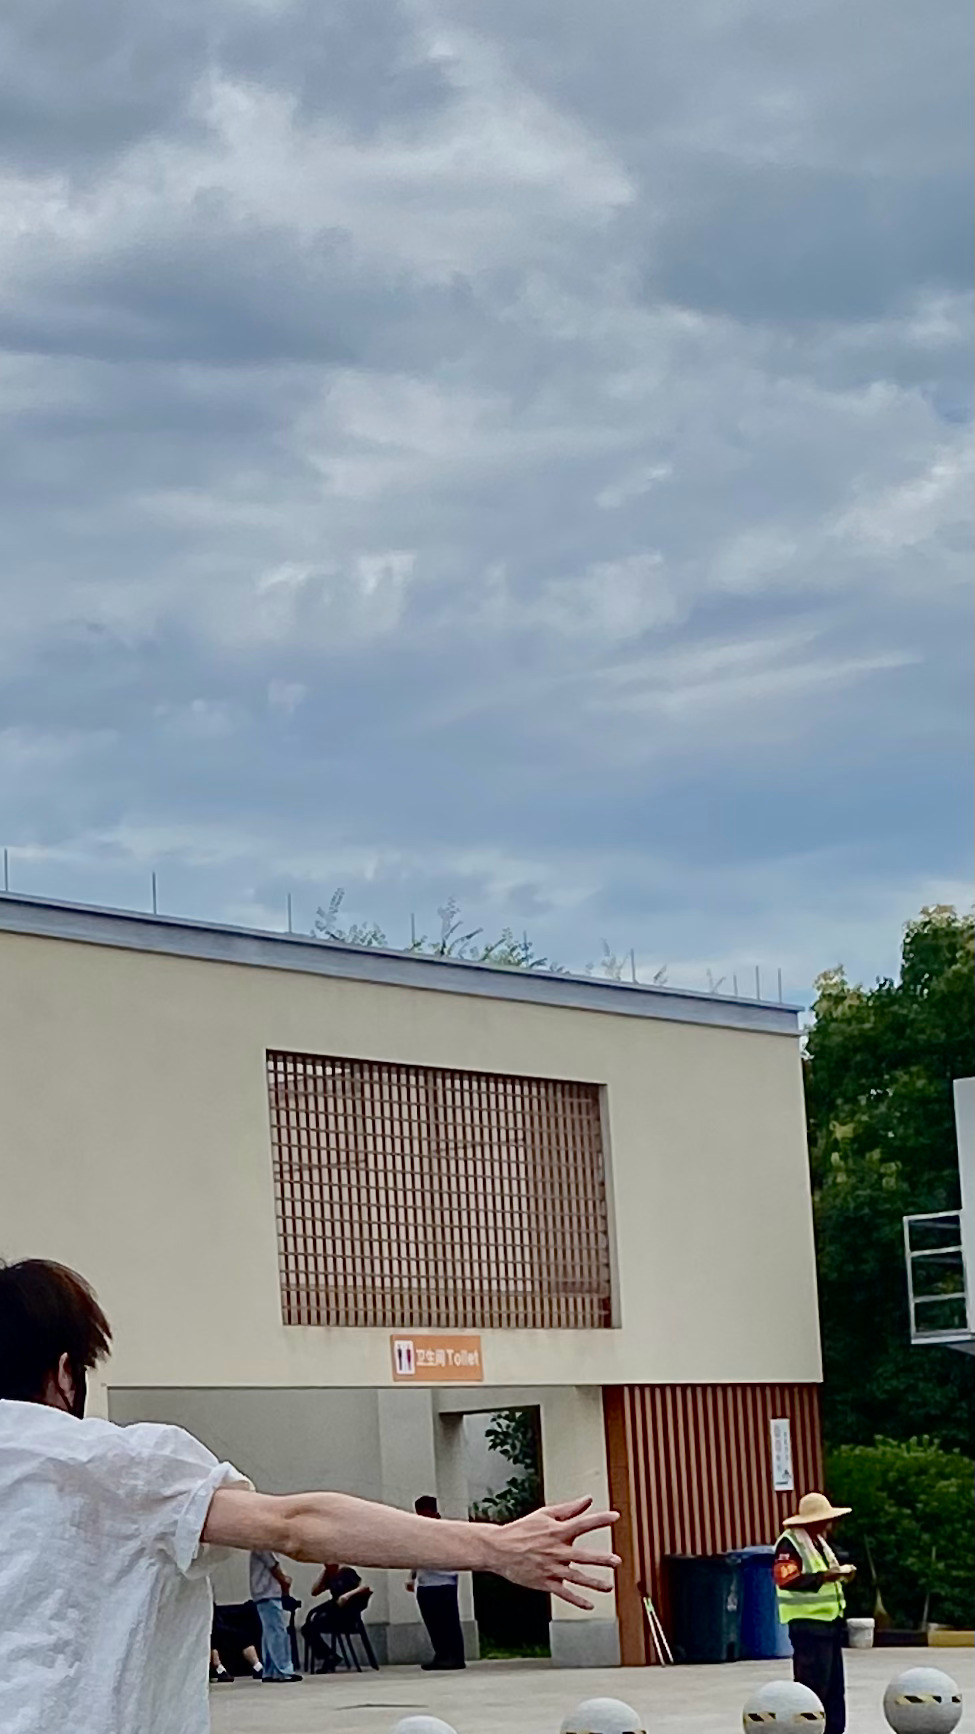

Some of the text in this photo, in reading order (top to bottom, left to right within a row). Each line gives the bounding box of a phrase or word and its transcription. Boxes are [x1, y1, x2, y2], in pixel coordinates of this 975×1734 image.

[415, 1347, 479, 1367] 卫生间 Toilet
